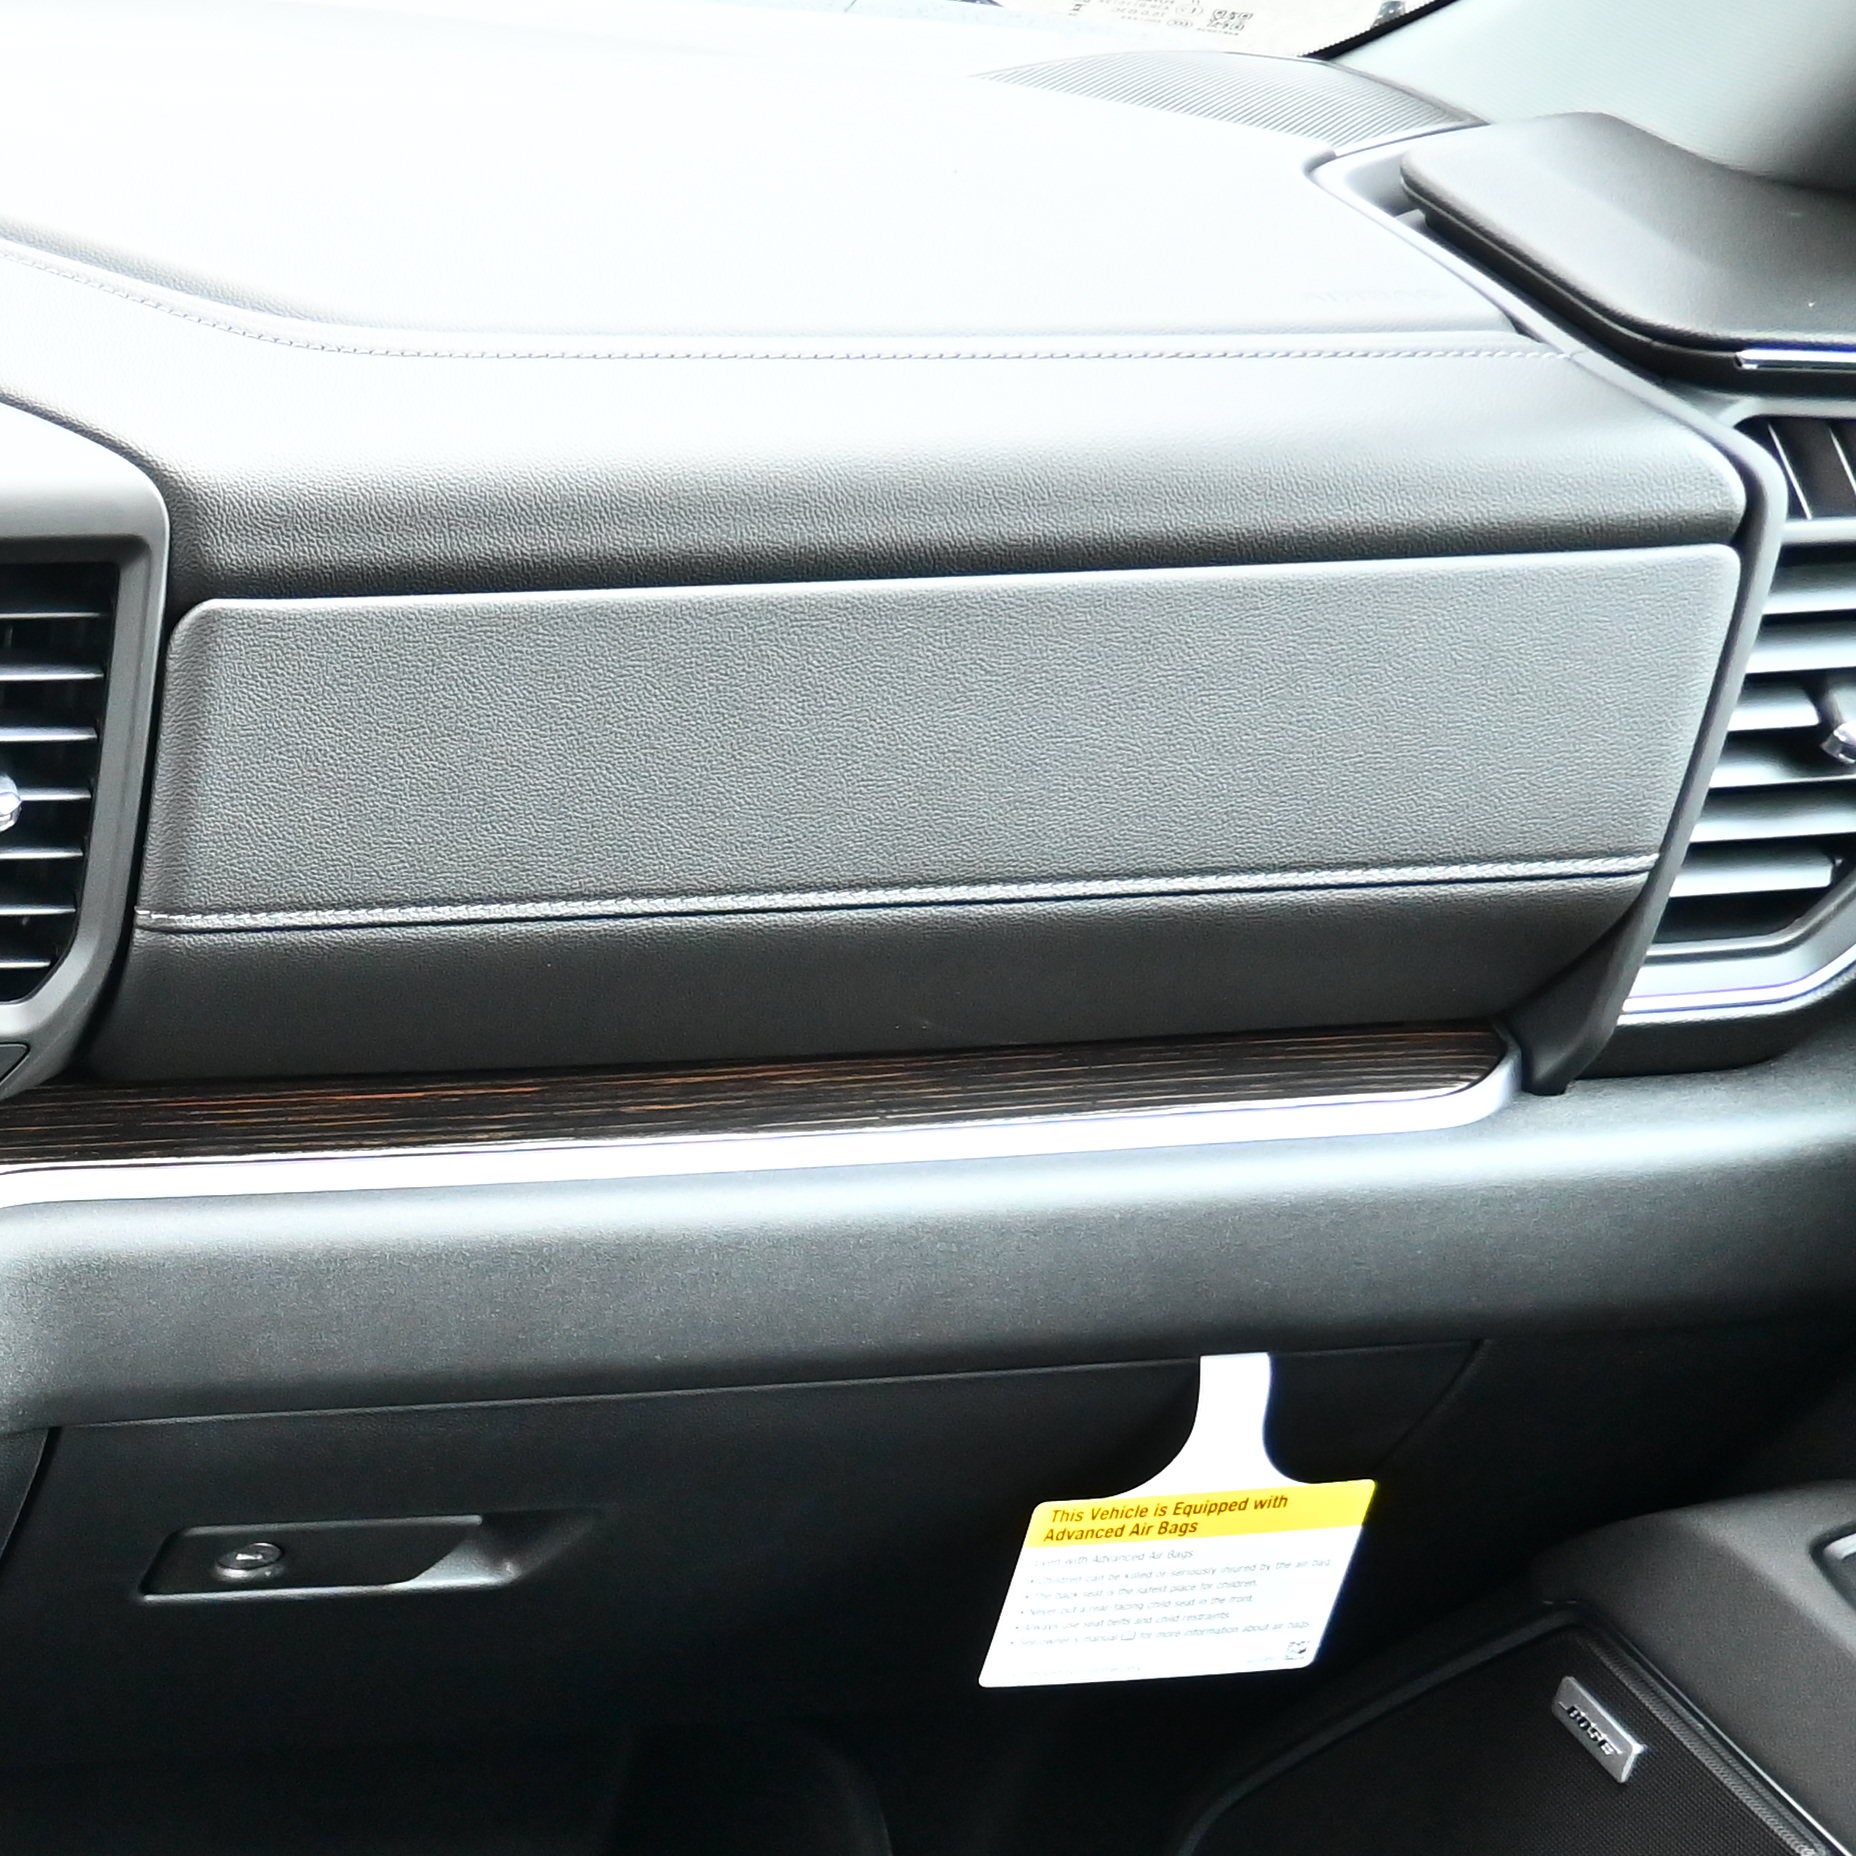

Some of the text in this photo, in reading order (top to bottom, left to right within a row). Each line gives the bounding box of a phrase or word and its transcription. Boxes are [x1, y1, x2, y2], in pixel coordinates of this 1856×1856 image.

[1052, 1495, 1288, 1522] This Vehicle is Equipped with
[1043, 1521, 1198, 1542] Advanced Air Bags
[1565, 1701, 1623, 1757] BOSE
